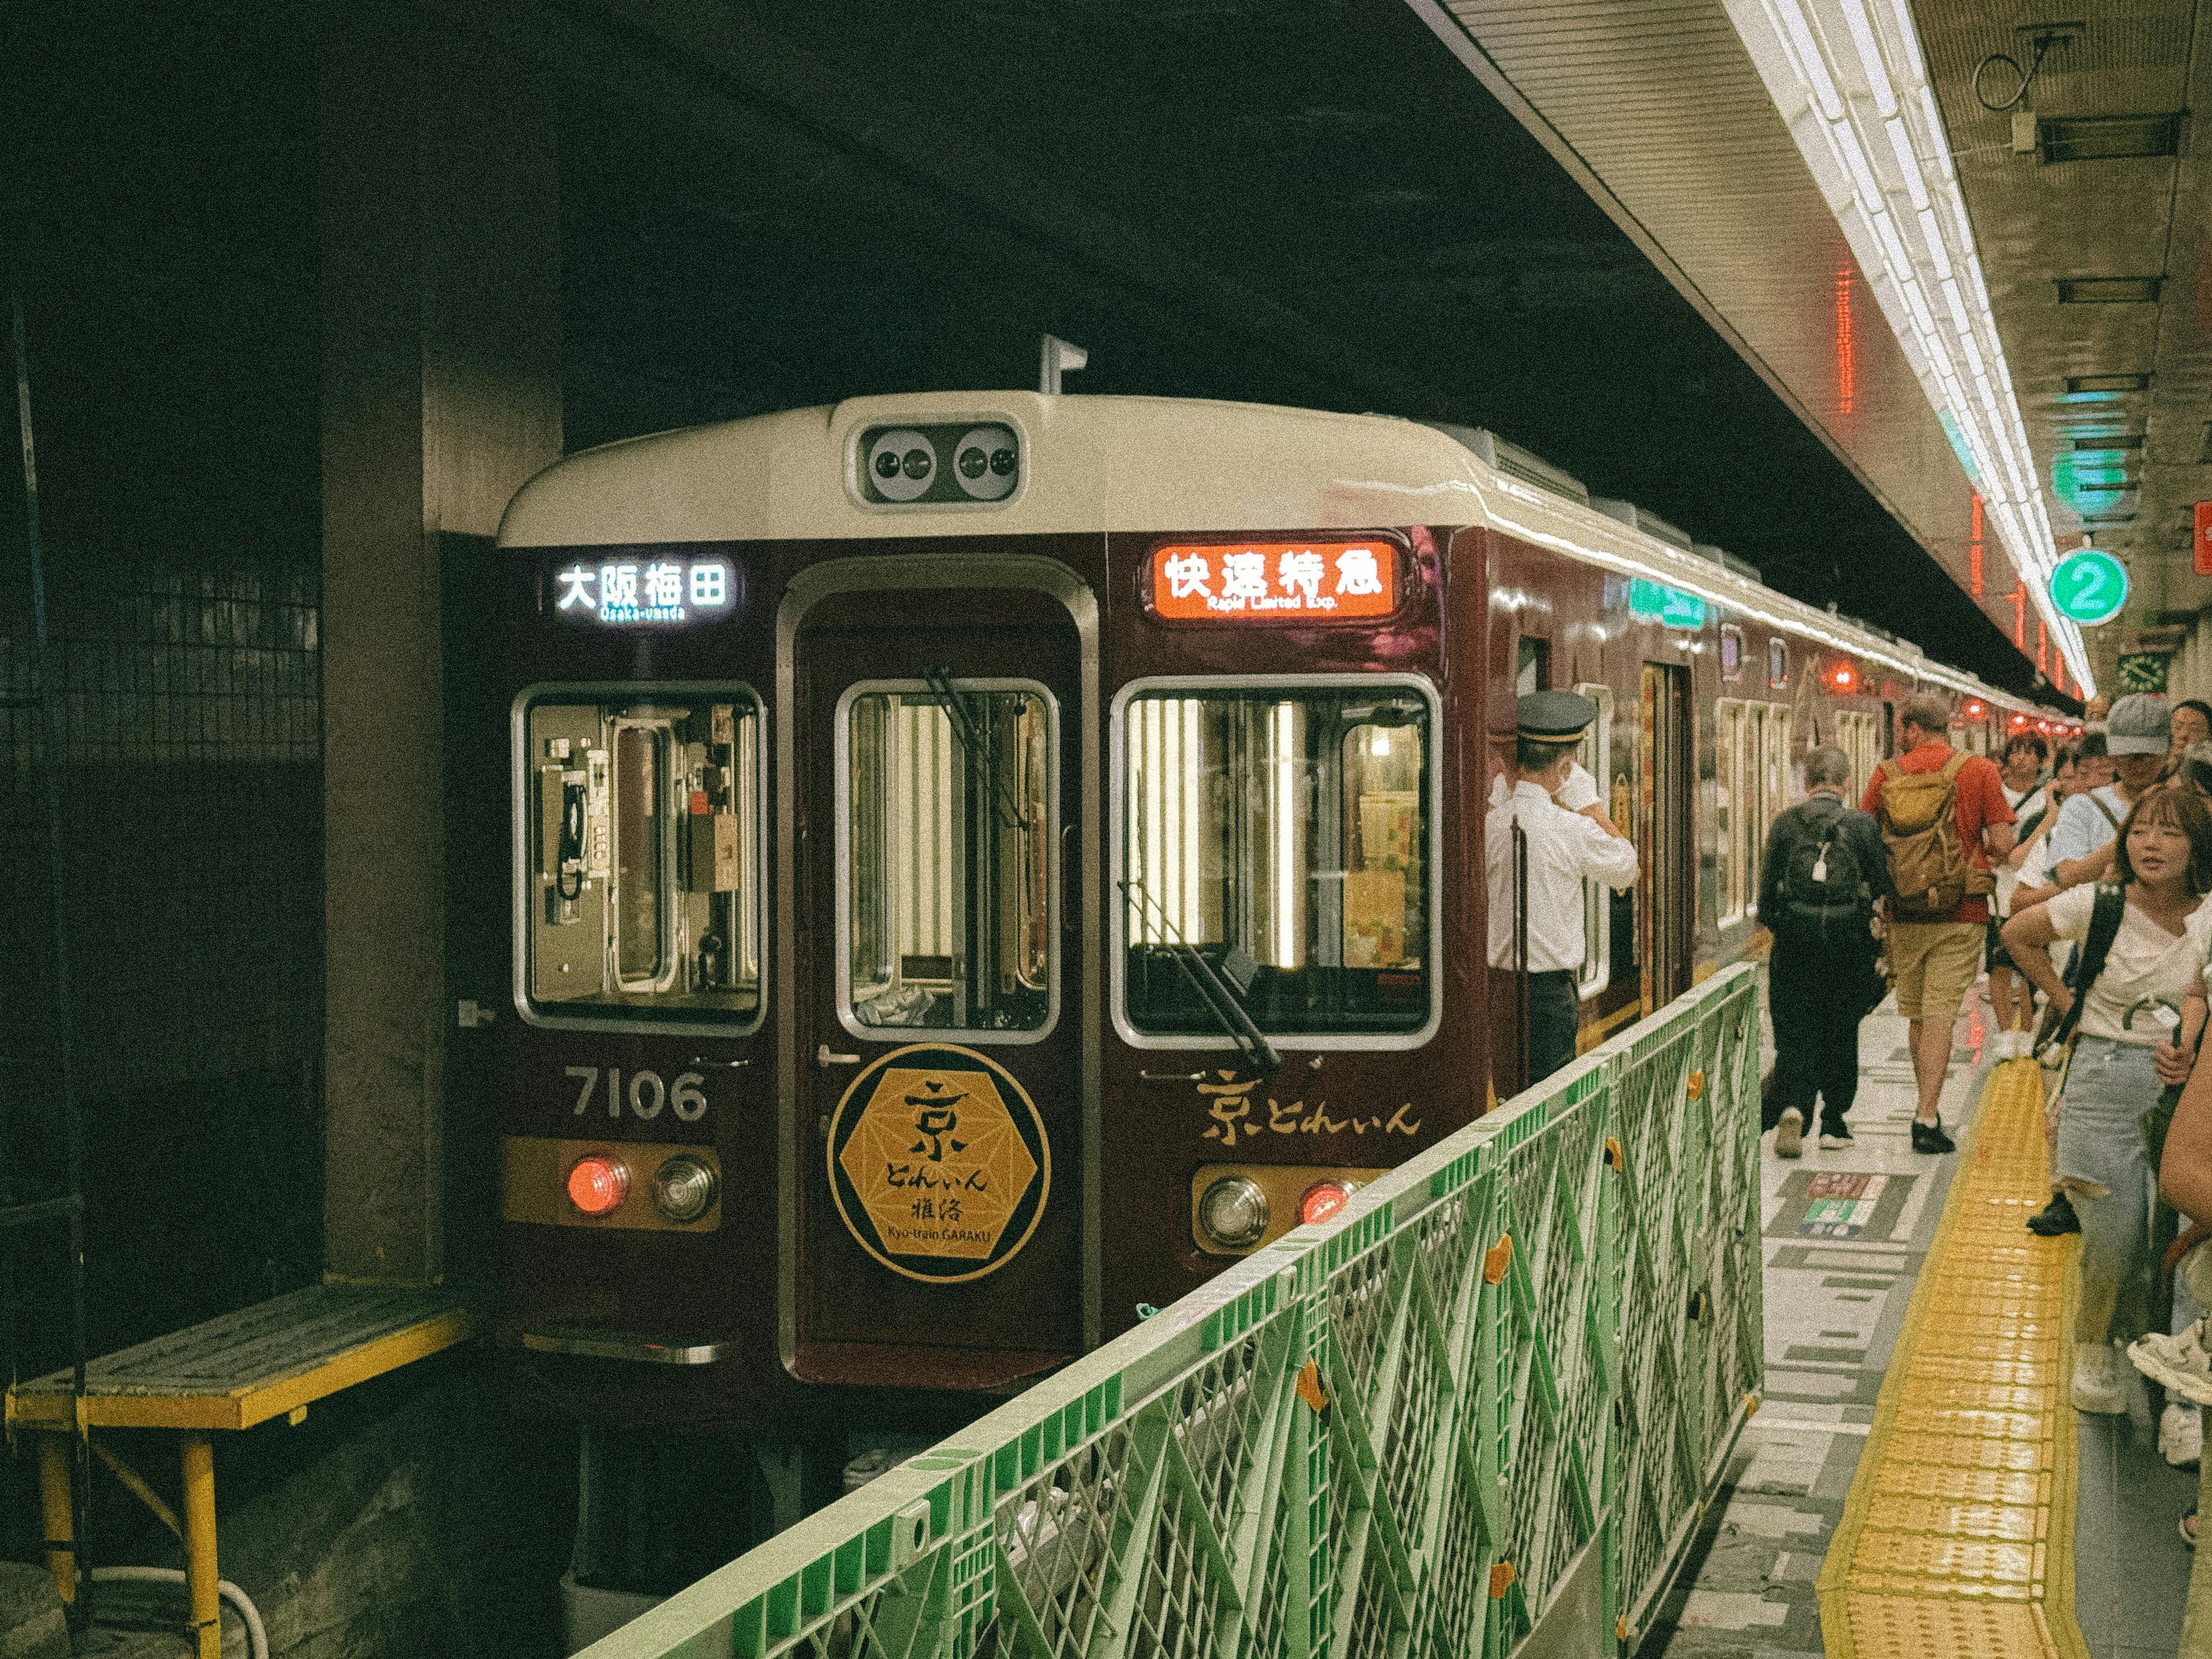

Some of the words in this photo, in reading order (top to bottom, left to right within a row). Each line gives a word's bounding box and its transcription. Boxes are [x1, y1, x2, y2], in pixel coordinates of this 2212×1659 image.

[558, 563, 726, 609] 大阪梅田
[1164, 549, 1383, 597] 快速特急
[2070, 562, 2107, 610] 2
[565, 1067, 707, 1121] 7106
[1197, 1070, 1421, 1146] 京とれいん
[905, 1081, 969, 1161] 京
[888, 1163, 988, 1192] とれいん
[911, 1198, 964, 1222] 雅洛
[888, 1227, 939, 1239] Kyo-train
[943, 1229, 991, 1242] GARAKU
